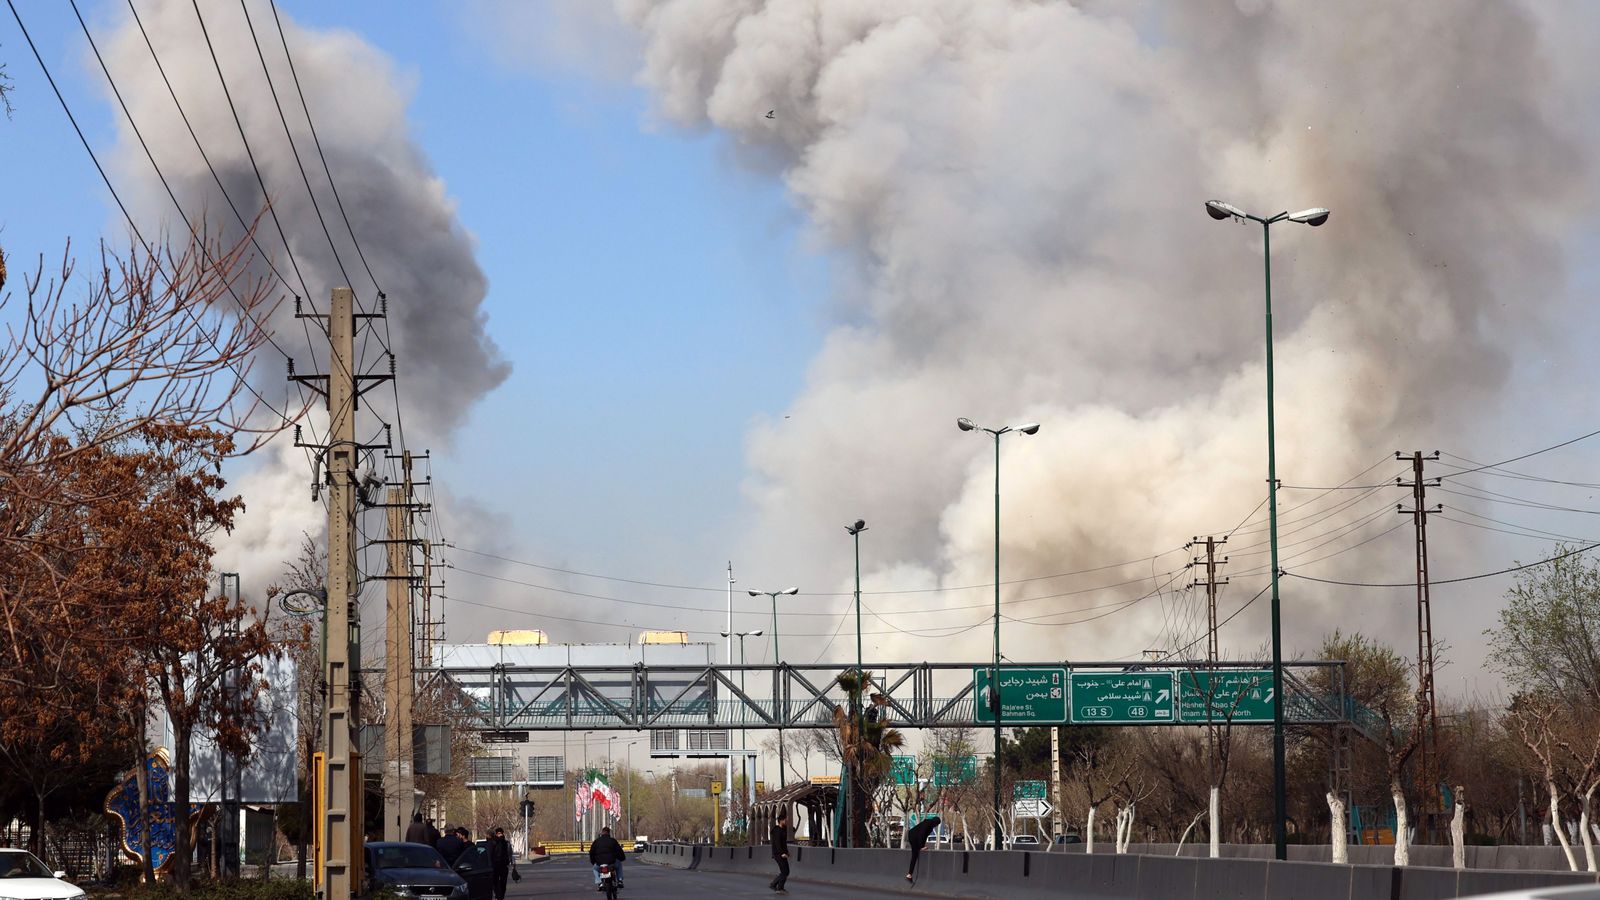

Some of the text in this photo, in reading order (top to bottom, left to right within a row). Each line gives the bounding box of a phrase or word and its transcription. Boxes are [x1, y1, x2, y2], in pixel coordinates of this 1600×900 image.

[1000, 675, 1048, 687] شهید رجایی
[1077, 679, 1099, 689] جنوب
[1127, 679, 1141, 689] امام
[1026, 691, 1048, 700] بهمن
[1097, 690, 1141, 702] شهید سلامی
[1087, 708, 1107, 716] 13 S
[1131, 707, 1145, 716] 48
